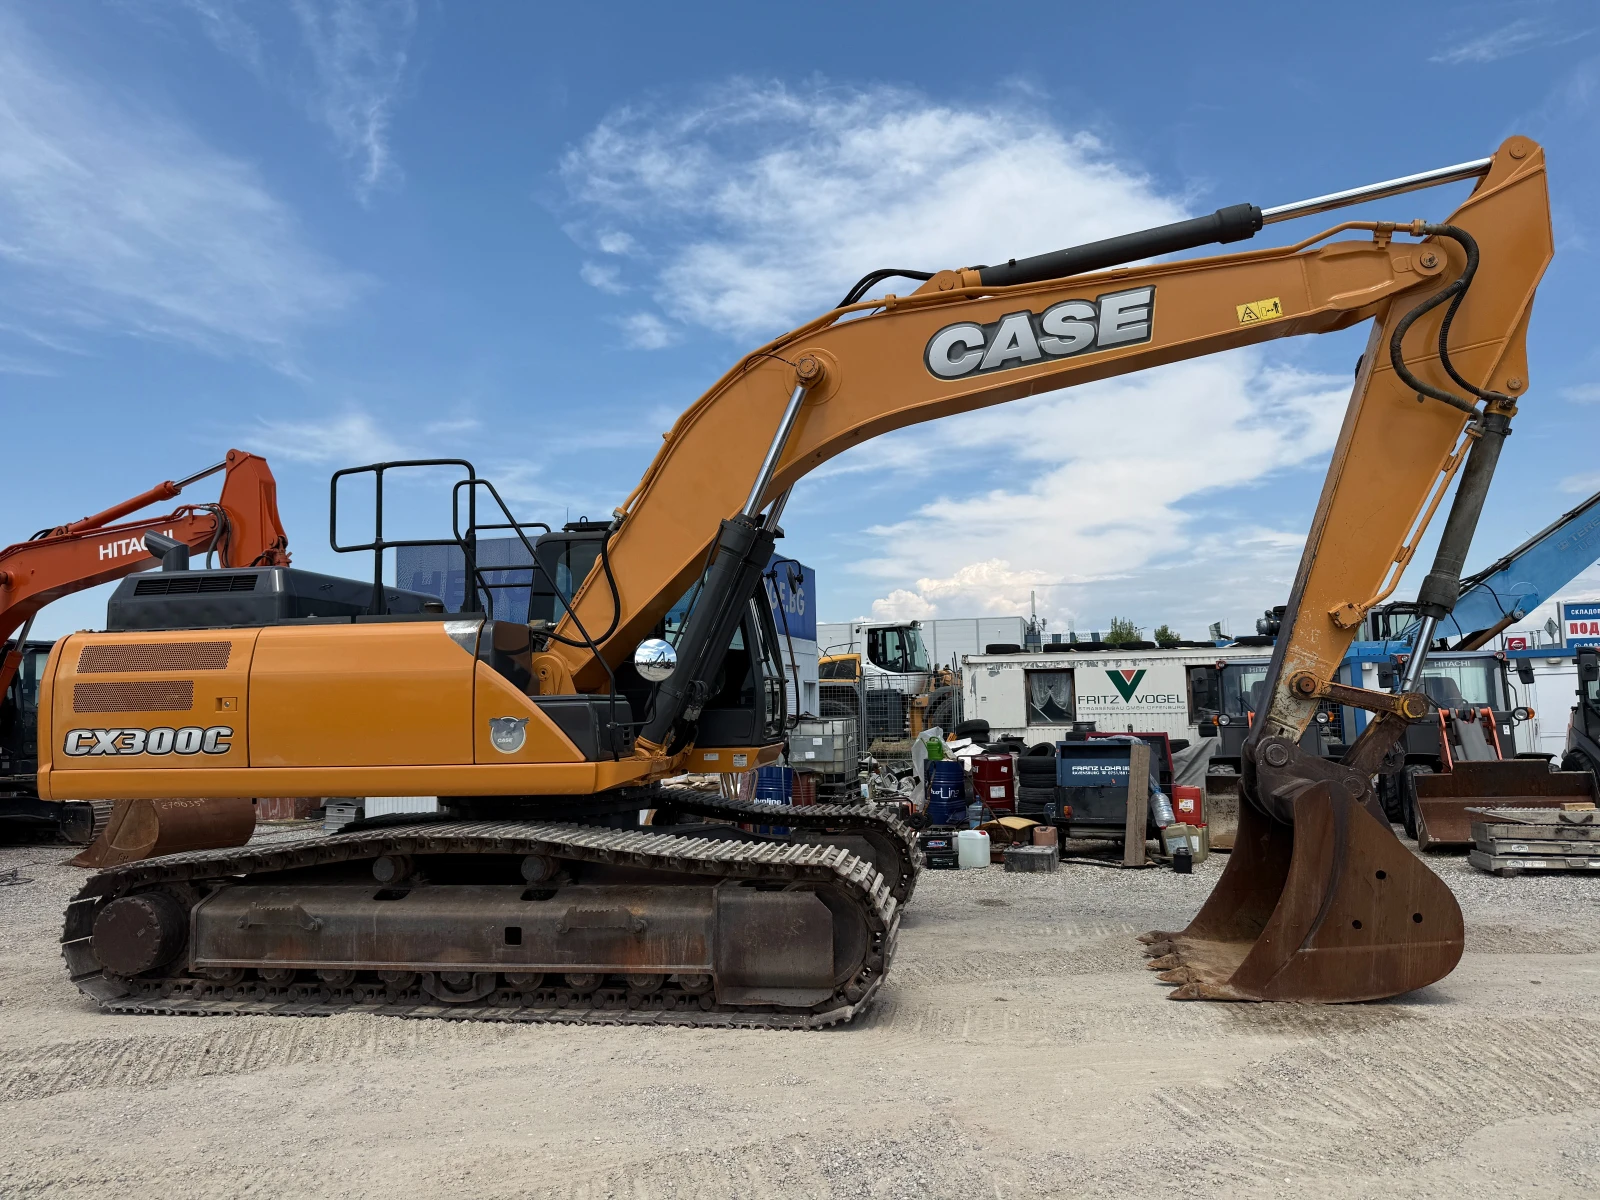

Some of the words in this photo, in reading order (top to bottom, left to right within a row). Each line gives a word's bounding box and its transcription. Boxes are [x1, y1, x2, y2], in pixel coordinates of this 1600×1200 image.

[925, 287, 1154, 380] CASE
[1569, 515, 1600, 541] TERE
[1569, 621, 1600, 636] ПОД
[1434, 660, 1471, 668] HITACHI
[1078, 695, 1120, 704] FRITZ
[1135, 694, 1185, 704] VOGEL
[63, 726, 234, 757] CX300C
